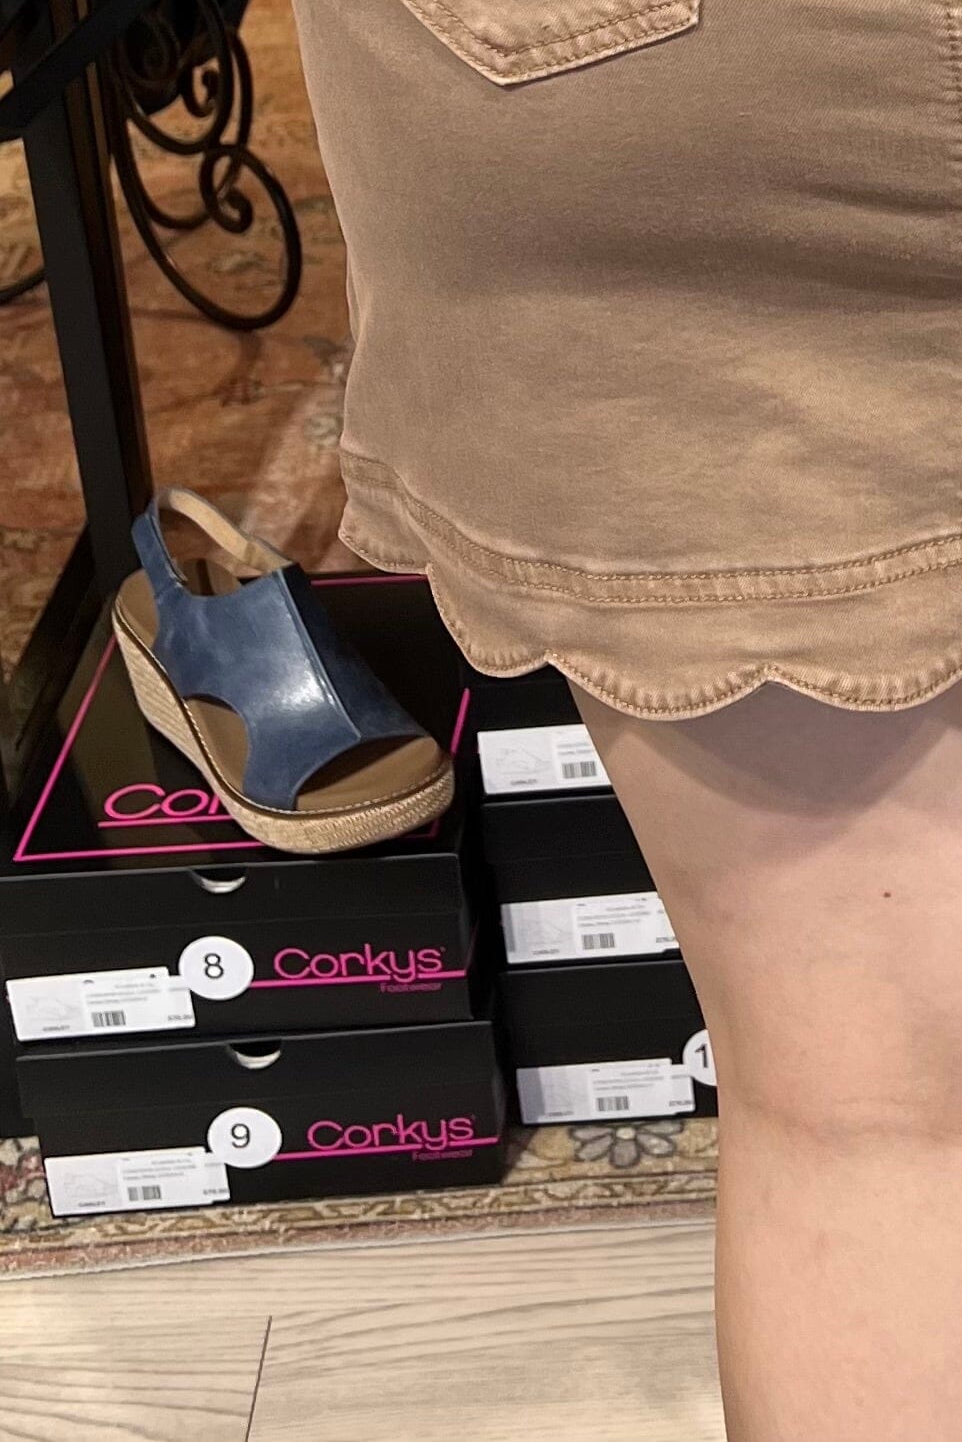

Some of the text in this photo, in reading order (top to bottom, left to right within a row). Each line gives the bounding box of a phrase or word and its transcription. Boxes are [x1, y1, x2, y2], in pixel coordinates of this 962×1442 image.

[204, 952, 222, 979] 8
[273, 943, 443, 983] Corkys
[695, 1043, 709, 1069] 1
[230, 1122, 251, 1149] 9
[306, 1113, 475, 1151] Corkys
